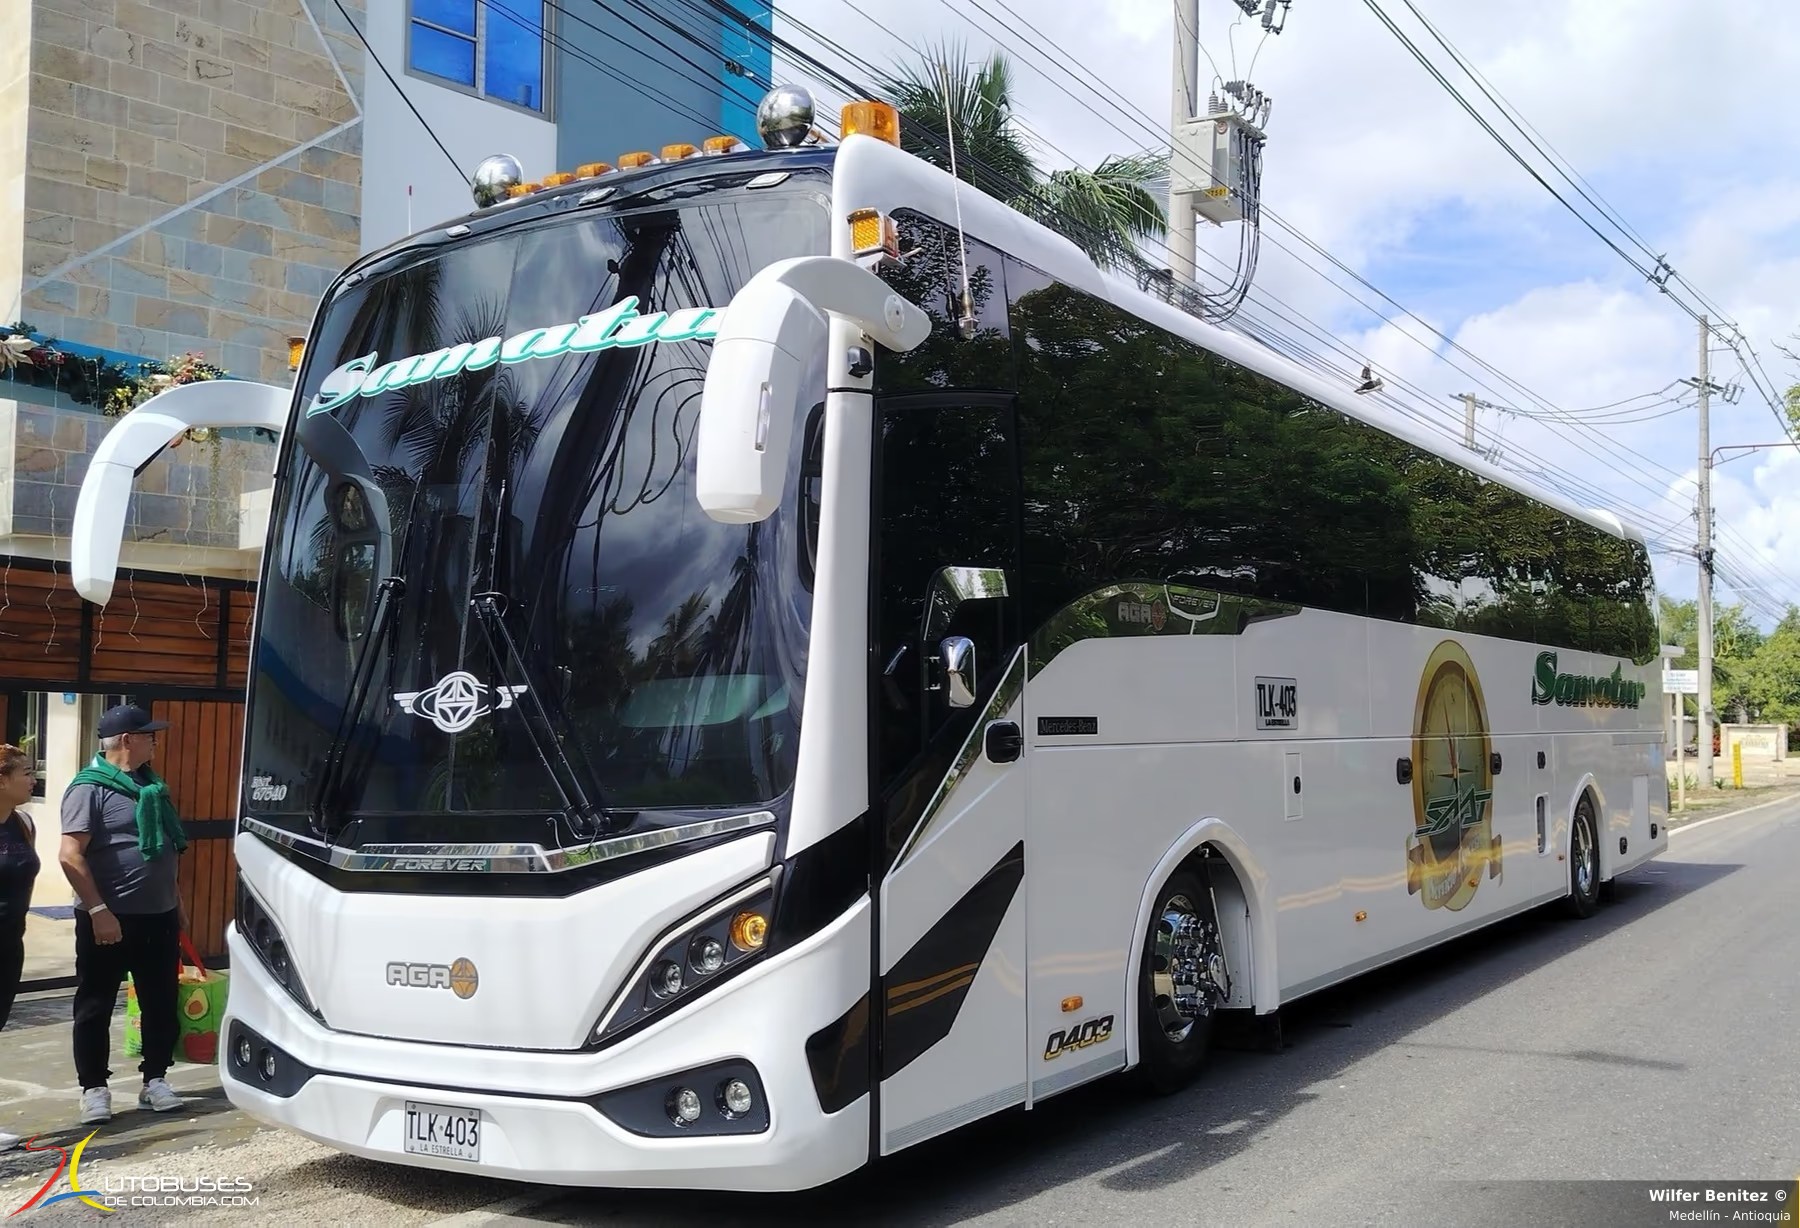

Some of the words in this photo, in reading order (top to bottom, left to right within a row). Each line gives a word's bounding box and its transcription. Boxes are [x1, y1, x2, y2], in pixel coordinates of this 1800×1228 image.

[307, 295, 729, 418] Samatu
[1118, 601, 1151, 623] AGA
[1531, 651, 1645, 709] Samatur
[392, 858, 487, 871] FOREVER
[386, 961, 451, 989] AGA
[420, 1143, 428, 1152] LA
[431, 1144, 463, 1156] ESTRELLA
